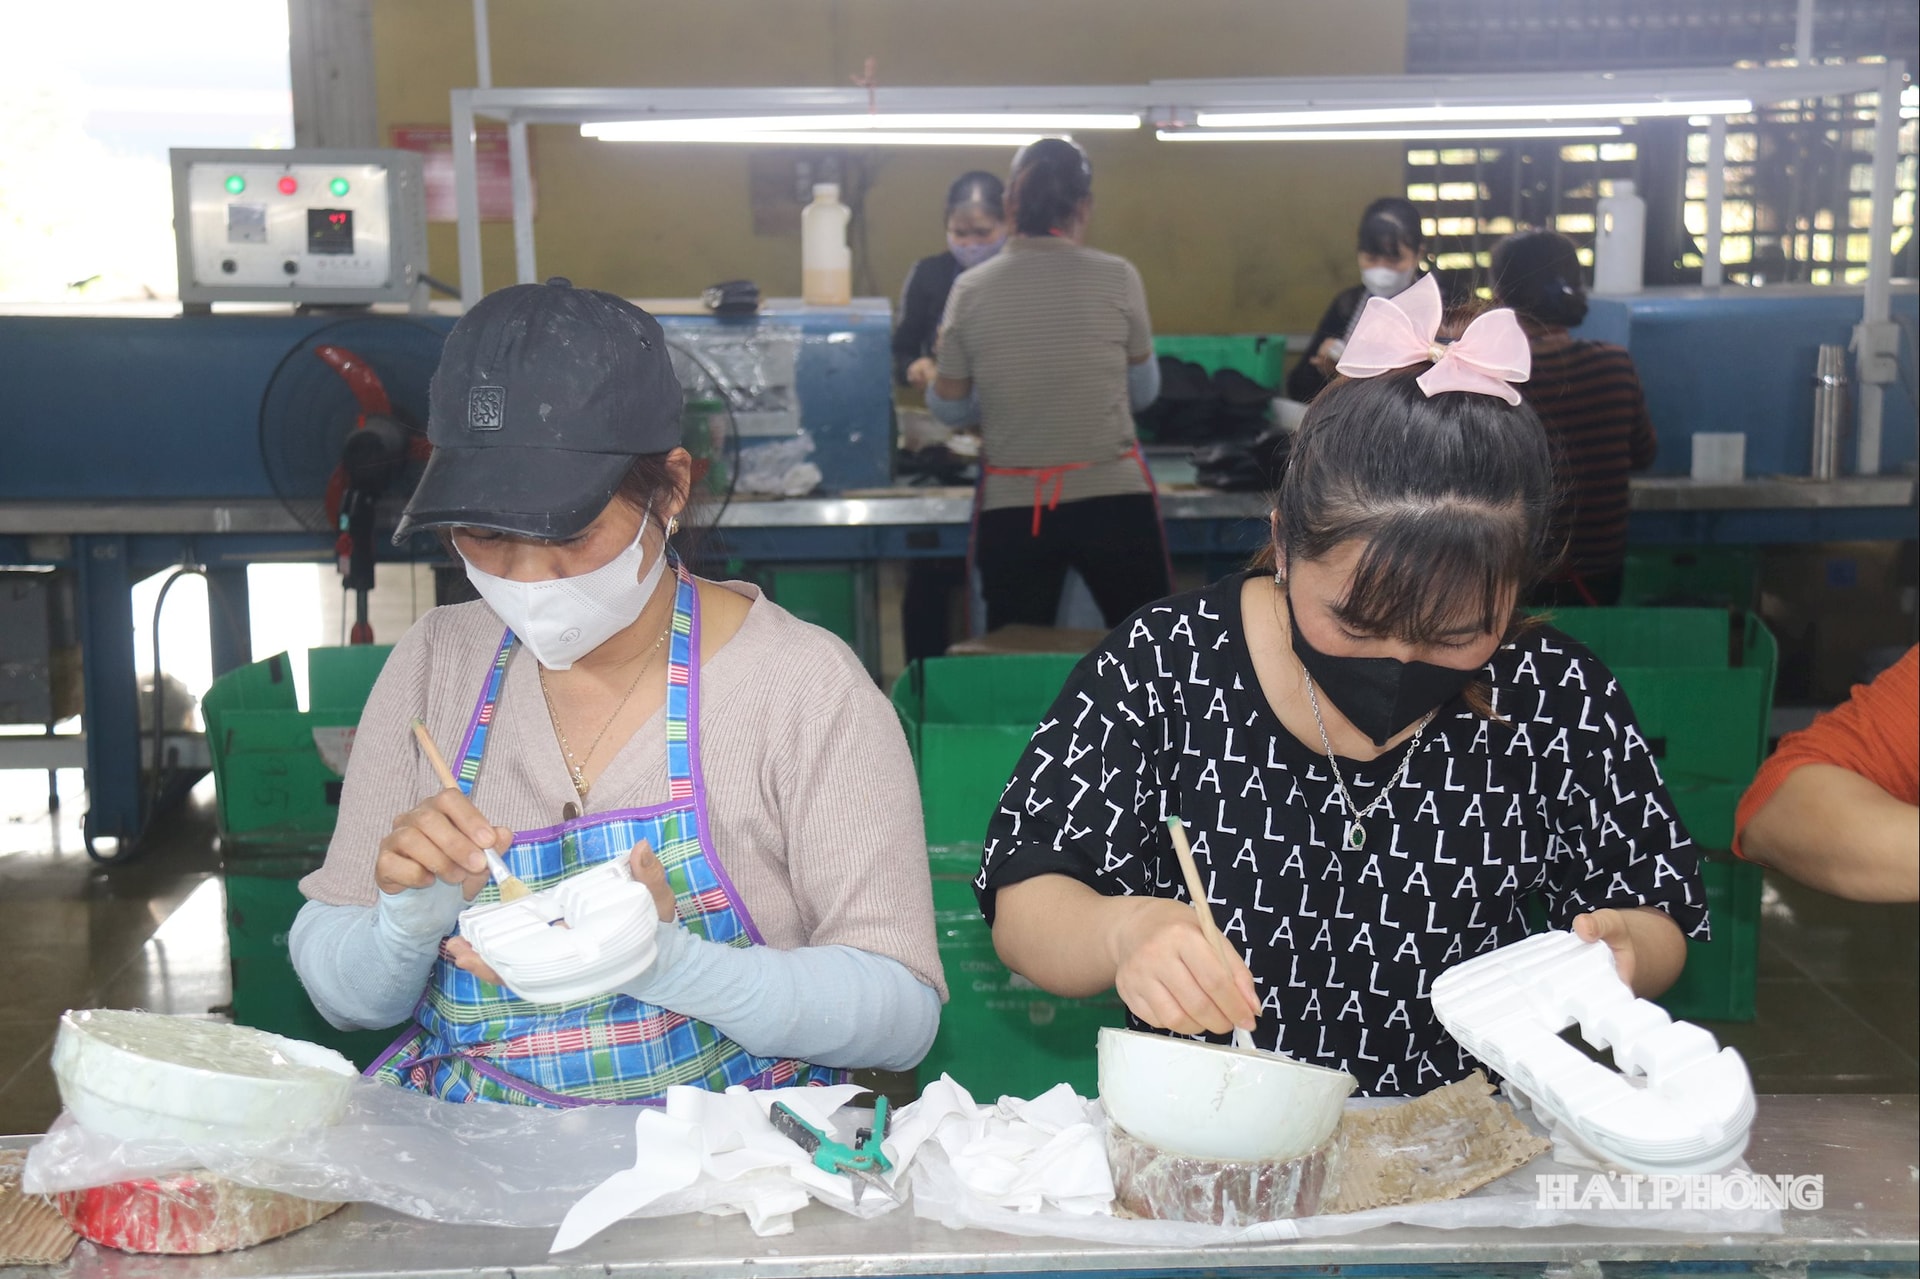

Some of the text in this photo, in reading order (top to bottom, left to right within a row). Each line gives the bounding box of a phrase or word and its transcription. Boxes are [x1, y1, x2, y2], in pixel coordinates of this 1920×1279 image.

[1198, 599, 1219, 620] L
[1128, 618, 1154, 648] A
[1169, 614, 1195, 646] A
[1154, 645, 1172, 677] L
[1189, 651, 1209, 685] L
[1512, 651, 1540, 684] A
[1558, 659, 1586, 690] A
[1119, 663, 1139, 693] L
[1073, 691, 1094, 729] L
[1146, 681, 1165, 717] A
[1204, 688, 1229, 722] A
[1491, 687, 1511, 721] L
[1533, 690, 1553, 724] L
[1578, 696, 1599, 732] L
[1101, 714, 1114, 752] L
[1183, 722, 1200, 756] L
[1224, 728, 1246, 763] L
[1468, 720, 1489, 754] A
[1505, 723, 1534, 756] A
[1542, 727, 1570, 763] A
[1624, 724, 1649, 761] A
[1031, 747, 1054, 783] L
[1063, 733, 1093, 768] A
[1267, 736, 1287, 770] L
[1098, 757, 1121, 793] A
[1196, 759, 1221, 793] A
[1240, 766, 1267, 801] A
[1444, 758, 1465, 791] L
[1486, 759, 1504, 793] L
[1610, 773, 1636, 805] L
[1026, 787, 1053, 817] A
[1067, 774, 1090, 811] L
[1134, 780, 1154, 815] A
[1414, 791, 1440, 824] A
[1001, 806, 1021, 836] L
[1105, 799, 1124, 837] L
[1217, 799, 1237, 834] L
[1264, 807, 1284, 841] L
[1459, 794, 1485, 827] A
[1502, 794, 1523, 827] A
[1642, 792, 1669, 828] A
[1309, 815, 1325, 847] L
[1390, 824, 1408, 859] L
[1599, 811, 1626, 847] A
[1669, 821, 1691, 849] L
[1103, 841, 1133, 872] A
[1232, 838, 1258, 872] A
[1280, 845, 1305, 878] A
[1434, 830, 1456, 864] L
[1483, 832, 1501, 865] L
[1521, 830, 1537, 863] L
[1627, 839, 1647, 866] L
[1156, 857, 1171, 887] L
[1358, 854, 1384, 887] A
[1403, 862, 1431, 896] A
[1452, 866, 1478, 898] A
[1495, 865, 1518, 896] A
[1585, 859, 1603, 880] L
[1606, 872, 1635, 899] A
[1654, 854, 1683, 888] A
[1254, 879, 1273, 913] L
[1299, 884, 1317, 918] L
[1335, 887, 1354, 919] L
[1380, 894, 1399, 928] L
[1426, 902, 1447, 933] L
[1468, 902, 1486, 928] L
[1269, 916, 1294, 949] A
[1310, 919, 1332, 951] A
[1348, 922, 1375, 955] A
[1393, 932, 1421, 964] A
[1442, 933, 1461, 962] A
[1475, 926, 1497, 952] A
[1289, 955, 1306, 987] L
[1326, 957, 1344, 988] L
[1369, 961, 1389, 996] L
[1301, 989, 1321, 1020] A
[1337, 990, 1364, 1022] A
[1384, 1000, 1411, 1029] A
[1317, 1026, 1334, 1057] L
[1358, 1028, 1378, 1061] L
[1405, 1033, 1419, 1061] L
[1375, 1064, 1399, 1092] A
[1418, 1051, 1442, 1084] A
